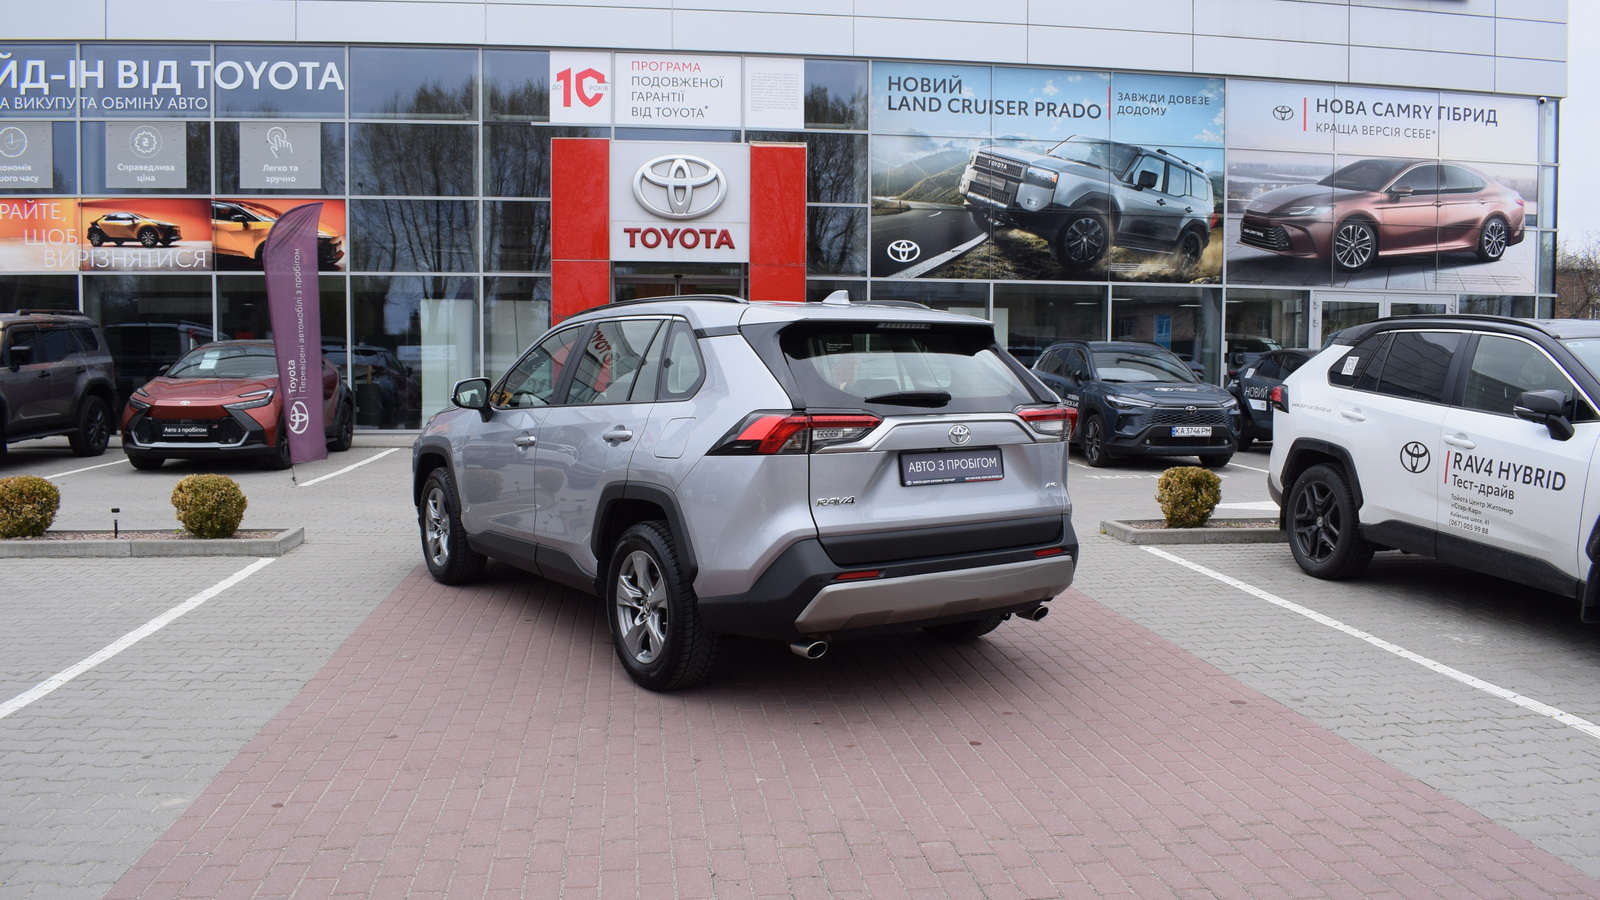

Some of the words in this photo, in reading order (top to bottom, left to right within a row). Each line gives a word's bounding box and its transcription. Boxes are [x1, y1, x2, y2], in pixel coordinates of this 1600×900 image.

[631, 60, 702, 72] ПРОГРАМА
[117, 60, 182, 95] ВІД
[190, 60, 345, 90] TOYOTA
[630, 76, 724, 89] ПОДОВЖЕНОЇ
[887, 75, 962, 94] НОВИЙ
[14, 97, 76, 110] ВИКУПУ
[80, 97, 98, 110] ТА
[102, 97, 164, 110] ОБМІНУ
[168, 98, 208, 110] АВТО
[630, 90, 684, 103] ГАРАНТІЇ
[1117, 92, 1166, 104] ЗАВЖДИ
[1168, 94, 1210, 106] ДОВЕЗЕ
[630, 107, 652, 118] ВІД
[887, 95, 942, 112] LAND
[947, 97, 1029, 116] CRUISER
[1035, 101, 1102, 120] PRADO
[1116, 105, 1167, 117] ДОДОМУ
[1316, 98, 1368, 116] НОВА
[1373, 102, 1432, 120] CAMRY
[1438, 105, 1498, 127] ГІБРИД
[1316, 122, 1358, 136] КРАЩА
[1362, 124, 1400, 138] ВЕРСІЯ
[117, 164, 175, 172] Справедлива
[988, 160, 1008, 170] TOYOTA
[20, 176, 40, 184] часу
[136, 174, 156, 182] ціна
[24, 228, 78, 248] ЩОБ
[624, 228, 736, 249] TOYOTA
[44, 250, 206, 268] ВИРІЗНЯТИСЯ
[293, 248, 303, 288] пробігом
[294, 296, 304, 343] автомобілі
[299, 344, 307, 393] Перевірені
[288, 359, 296, 394] Toyota
[1244, 386, 1268, 398] НОВИЙ
[908, 460, 936, 472] АВТО
[947, 458, 997, 470] ПРОБІГОМ
[1452, 452, 1494, 476] RAV4
[1498, 460, 1566, 491] HYBRID
[1452, 474, 1515, 500] Тест-драйв
[816, 496, 856, 507] RAV4
[1451, 494, 1468, 503] Тойота
[1469, 498, 1486, 508] Центр
[1486, 502, 1514, 515] Житомир
[1450, 510, 1469, 520] Київське
[1449, 519, 1462, 528] (067)
[1463, 522, 1473, 530] 005
